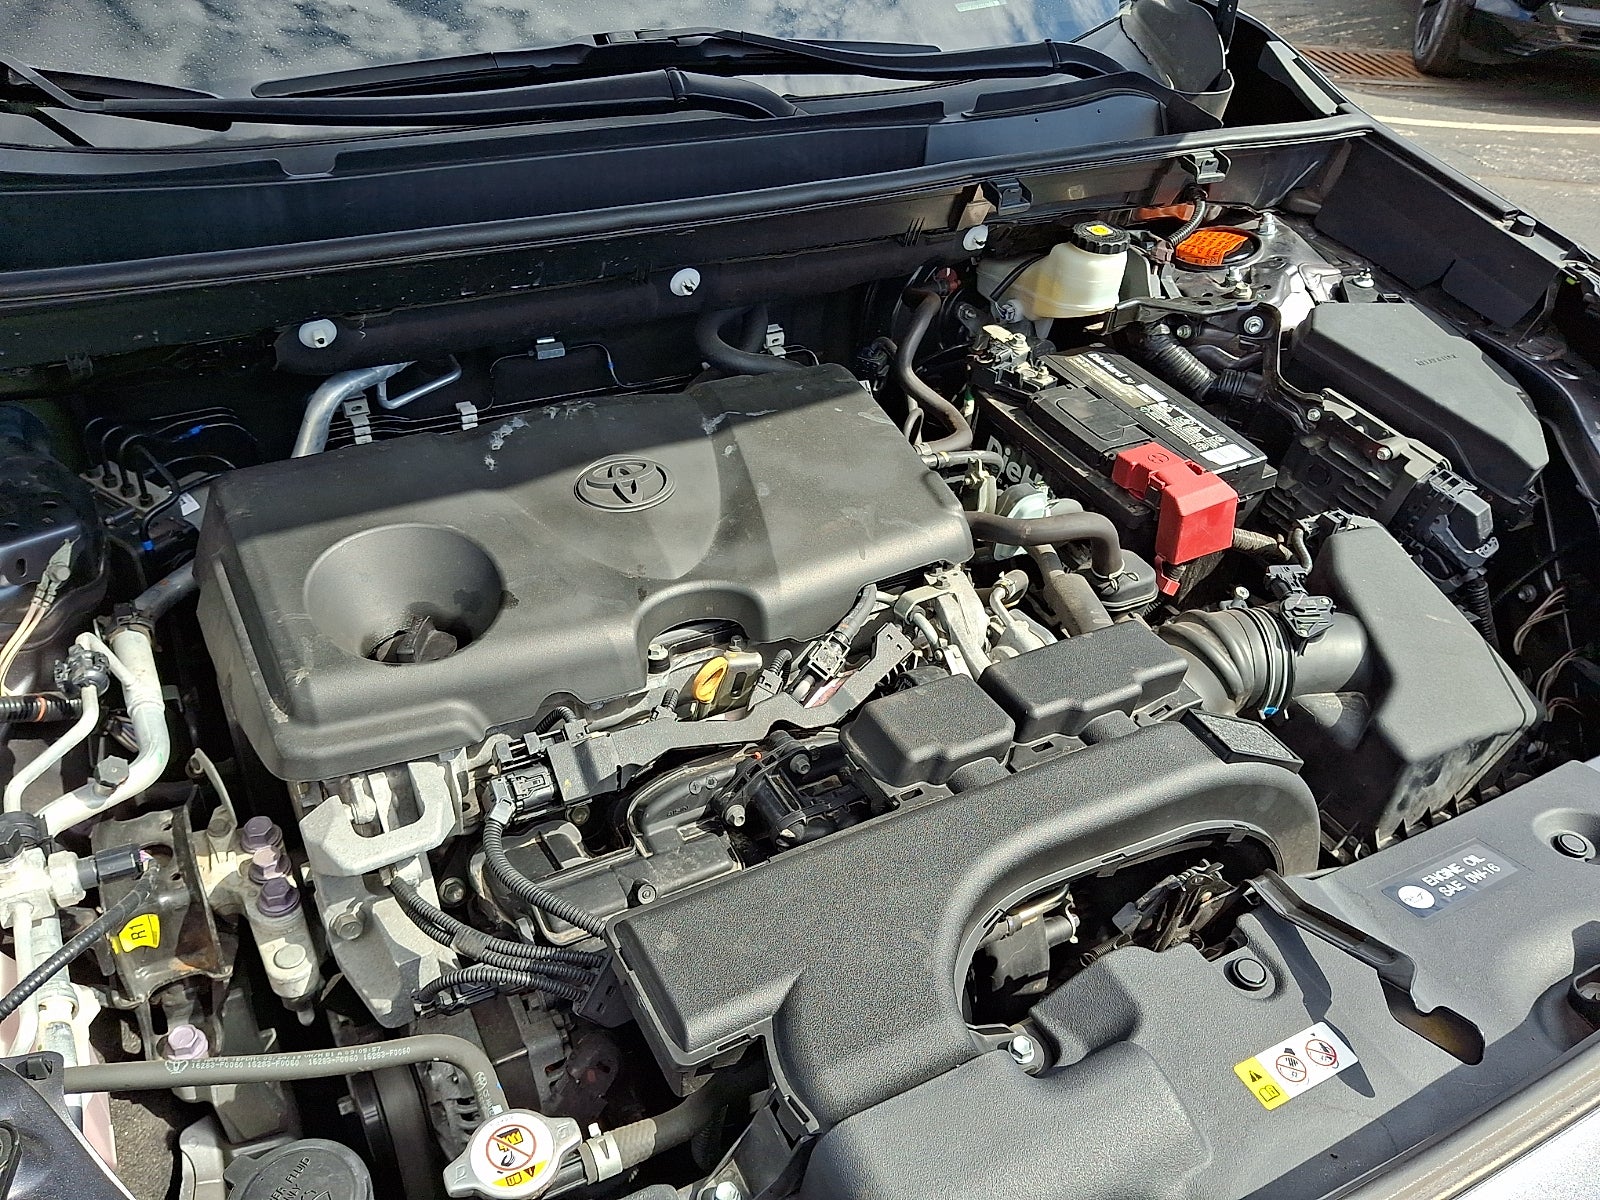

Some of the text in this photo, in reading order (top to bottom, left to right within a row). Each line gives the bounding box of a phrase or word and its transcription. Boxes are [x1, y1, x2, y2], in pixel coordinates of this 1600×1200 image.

[1088, 353, 1128, 378] DieHard
[986, 434, 1043, 489] DieH
[1422, 854, 1486, 886] ENGINE OIL
[1439, 863, 1500, 897] SAE 0W-16
[129, 923, 147, 940] R1
[285, 1156, 311, 1184] FLUID
